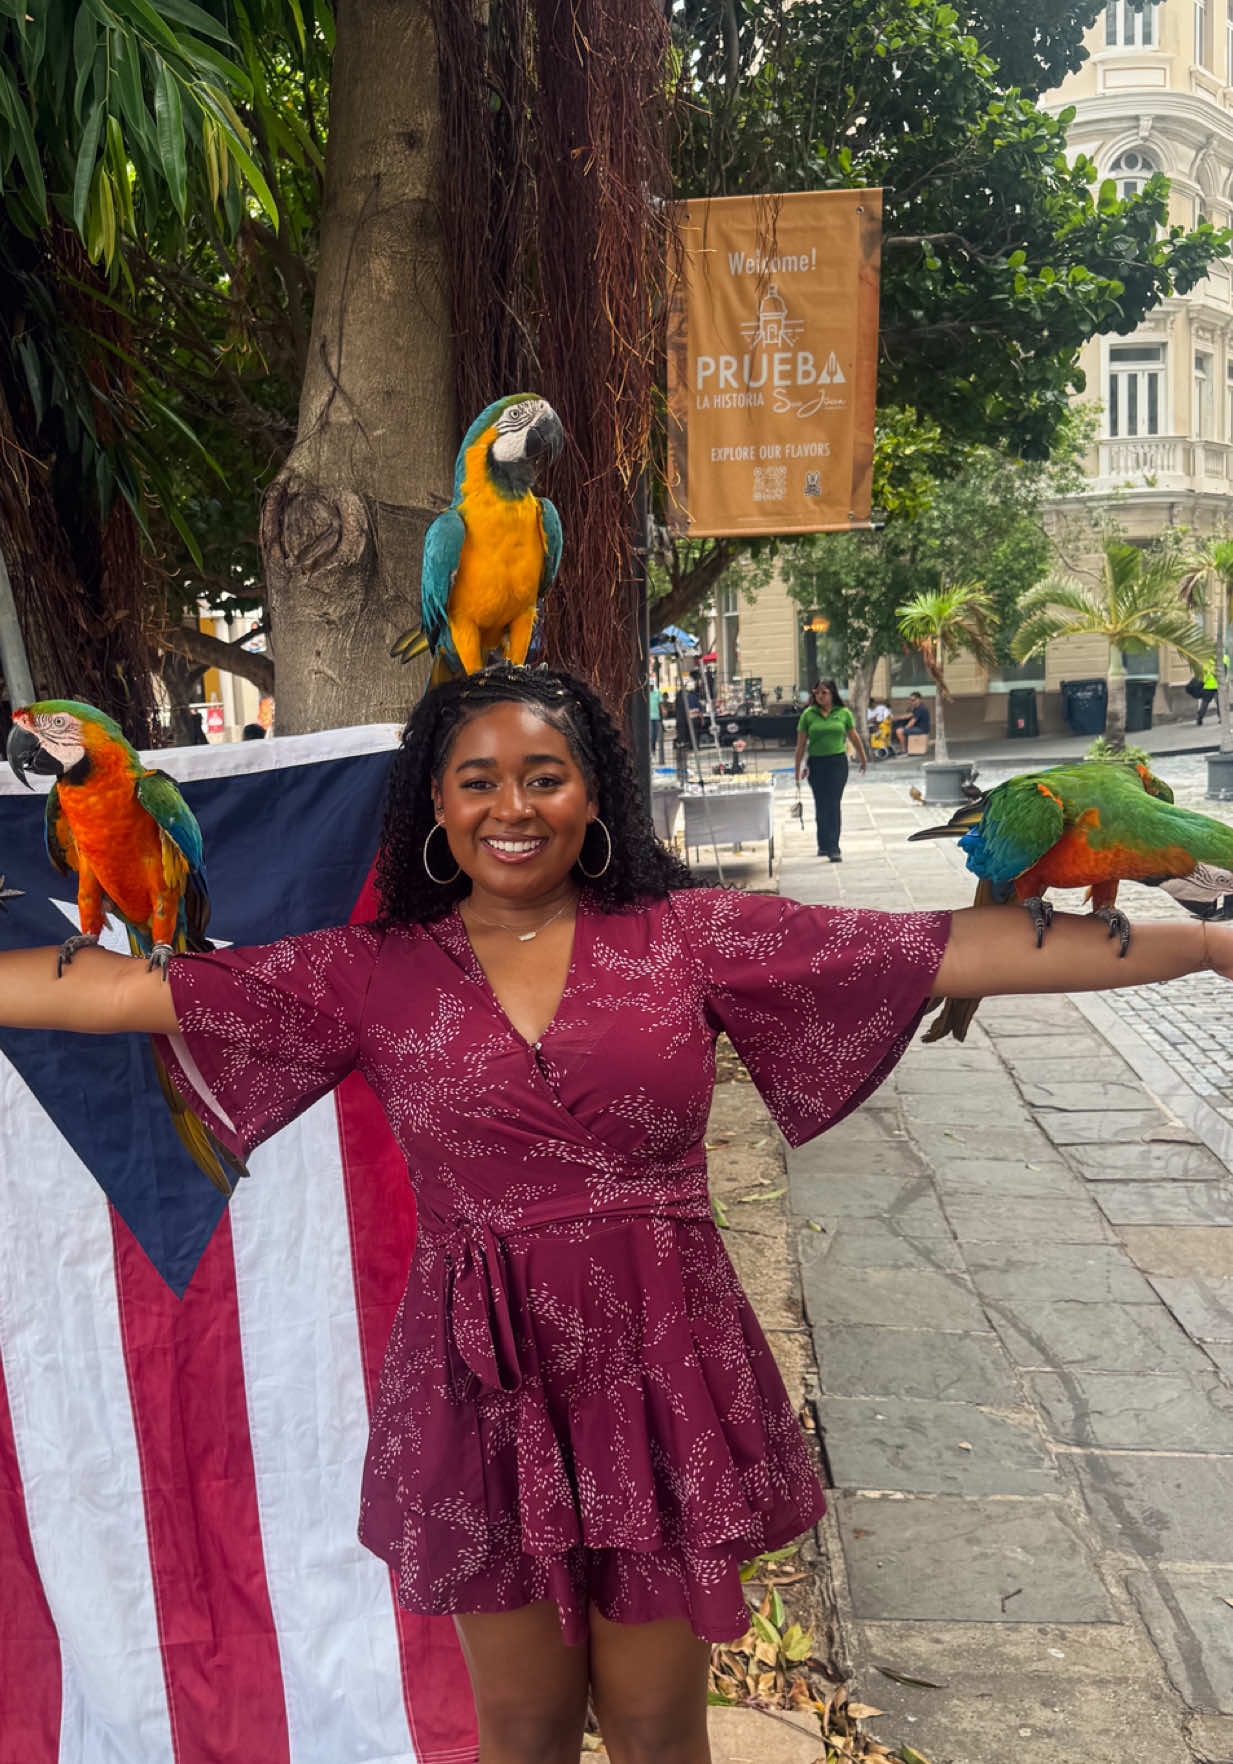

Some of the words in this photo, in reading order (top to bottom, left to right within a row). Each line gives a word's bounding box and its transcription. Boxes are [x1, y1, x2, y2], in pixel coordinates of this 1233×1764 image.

[728, 247, 816, 276] Welcome!
[696, 351, 846, 390] PRUEBA
[696, 395, 710, 410] LA
[713, 392, 764, 409] HISTORIA
[711, 446, 755, 462] EXPLORE
[760, 445, 781, 459] OUR
[785, 442, 831, 457] FLAVORS
